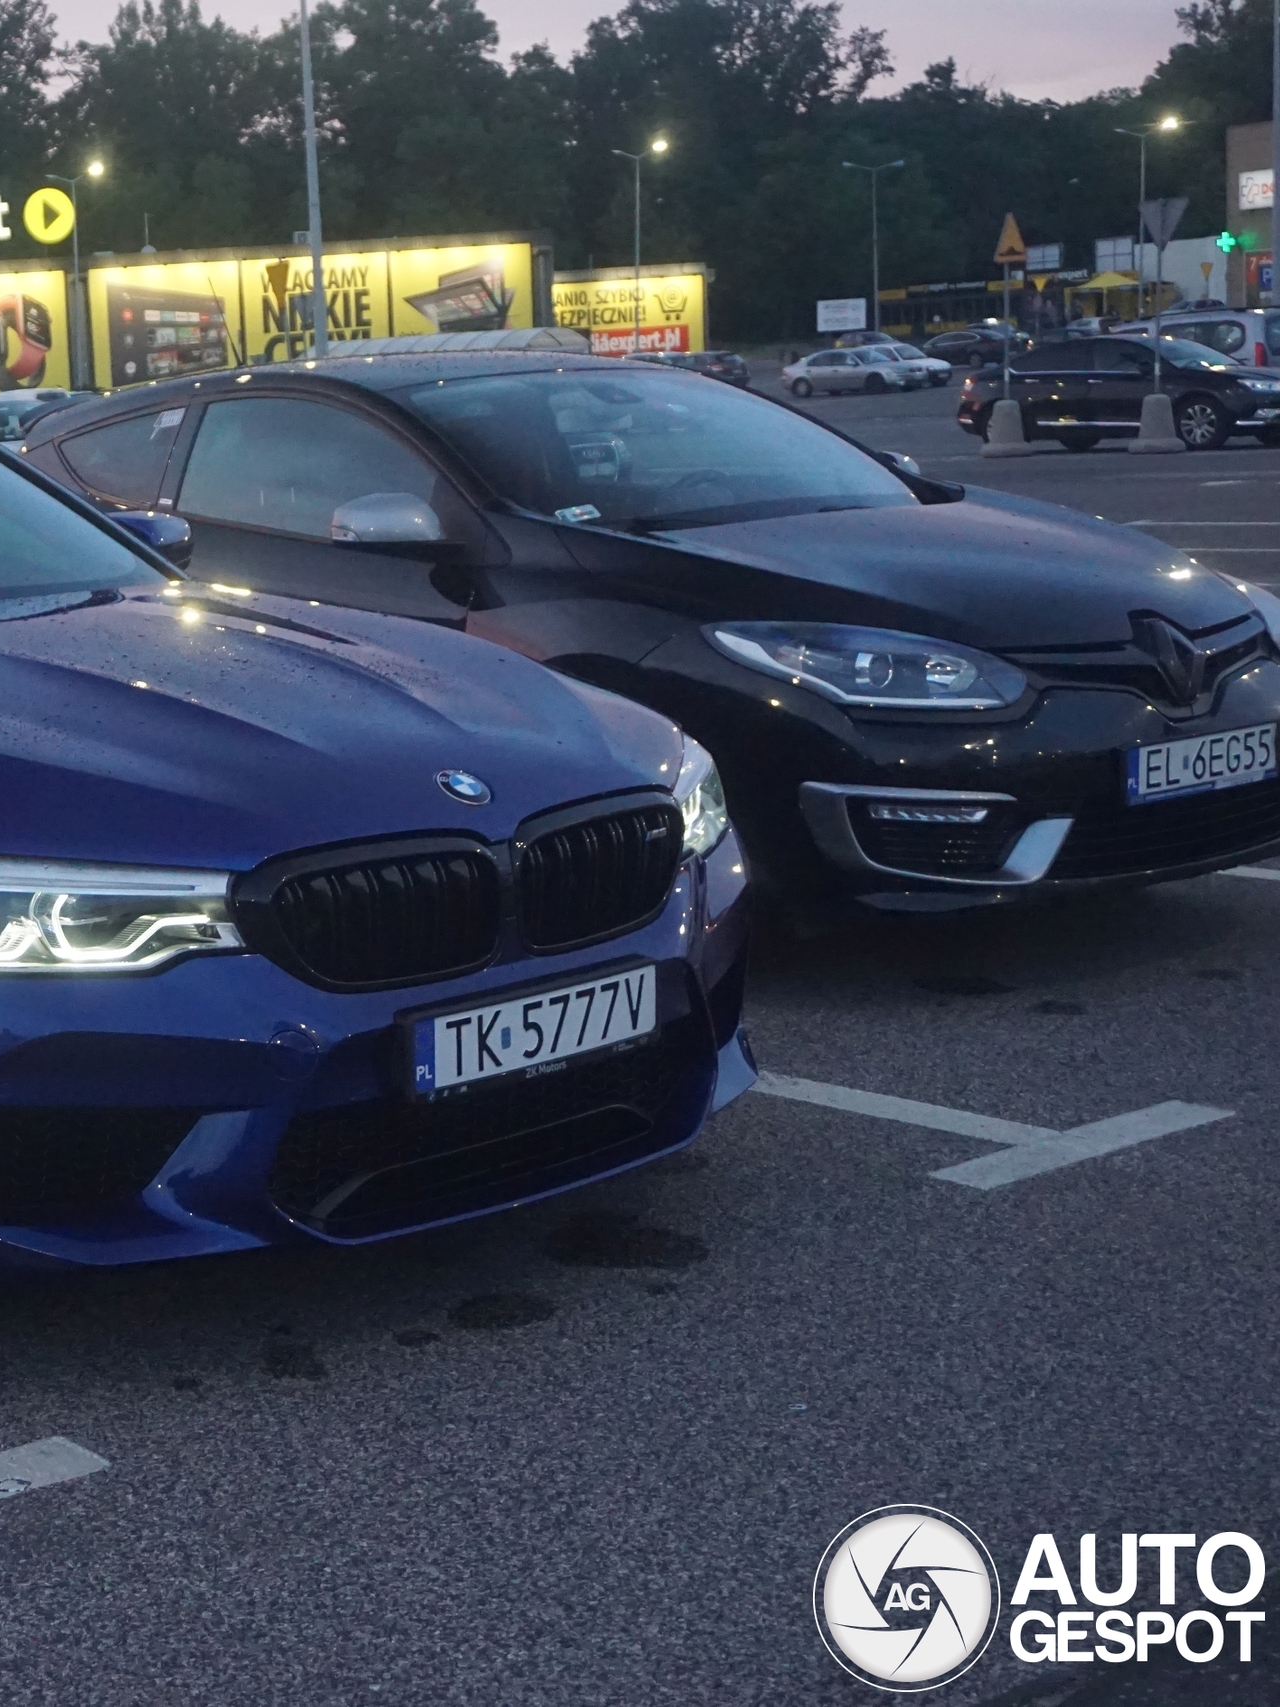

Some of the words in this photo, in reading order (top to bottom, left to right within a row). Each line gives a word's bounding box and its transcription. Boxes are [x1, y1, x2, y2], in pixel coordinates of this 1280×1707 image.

[554, 289, 591, 308] ANIO,
[595, 286, 646, 304] SZYBKO
[262, 288, 372, 334] NIKIE
[554, 305, 647, 327] EZPIECZNIE!
[1146, 747, 1180, 789] EL
[1193, 729, 1271, 780] 6EG55
[1128, 778, 1138, 789] PL
[446, 1010, 503, 1077] TK
[523, 973, 645, 1058] 5777V
[416, 1065, 432, 1082] PL
[539, 1061, 567, 1074] Motors
